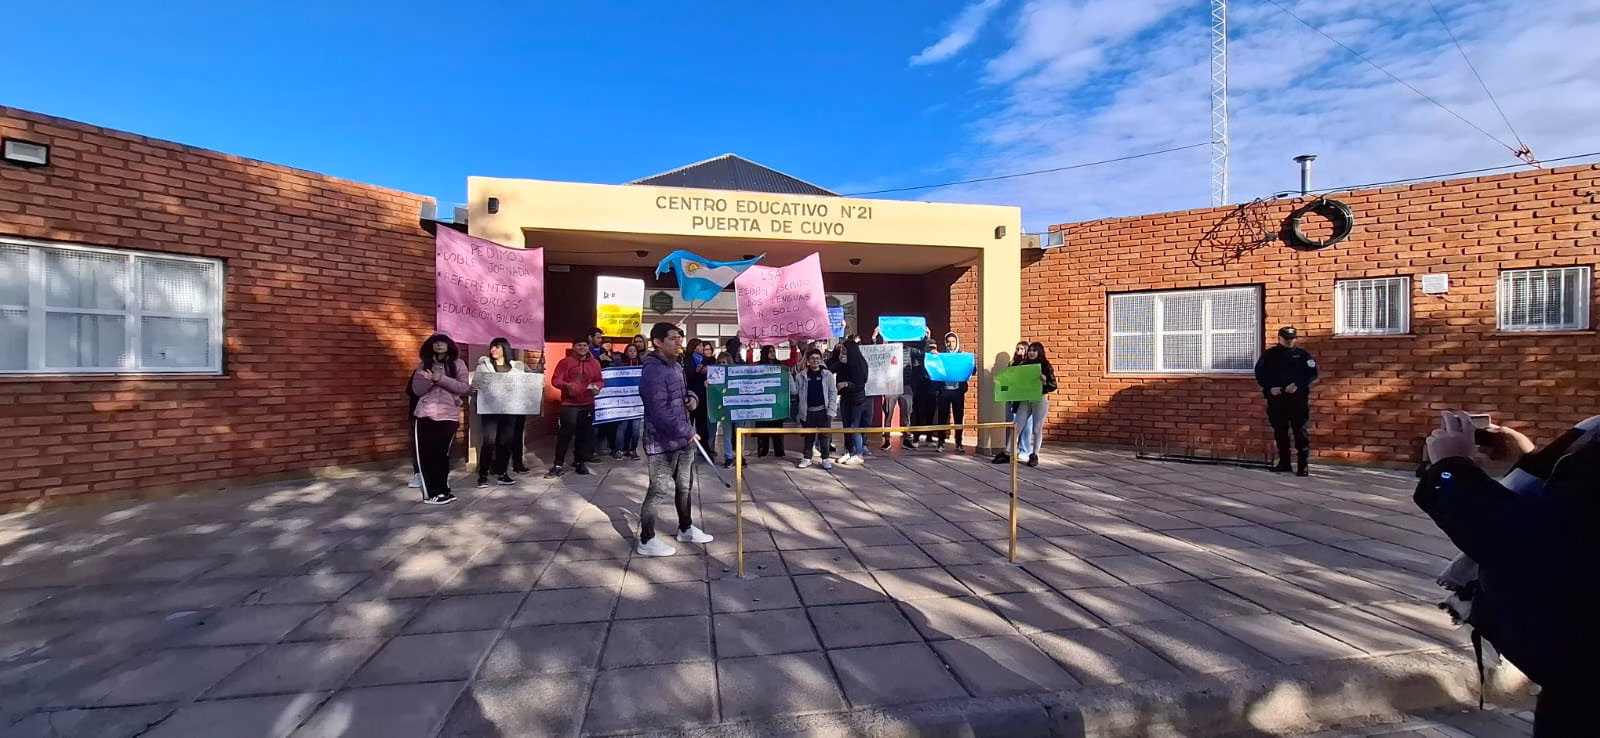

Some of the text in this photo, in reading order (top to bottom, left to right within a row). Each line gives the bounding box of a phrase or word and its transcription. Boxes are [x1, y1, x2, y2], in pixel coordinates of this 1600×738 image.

[656, 196, 728, 212] CENTRO
[736, 200, 828, 217] EDUCATIVO
[692, 216, 845, 236] PUERTA DE CUYO
[471, 243, 525, 263] PEDIMOS
[443, 251, 530, 277] DOBLE JORNADA
[444, 272, 516, 295] REFERENTES
[738, 287, 768, 296] ESPAÑL
[771, 293, 811, 304] LENGUAS
[772, 306, 800, 315] SOLO
[751, 319, 816, 339] DERECHO
